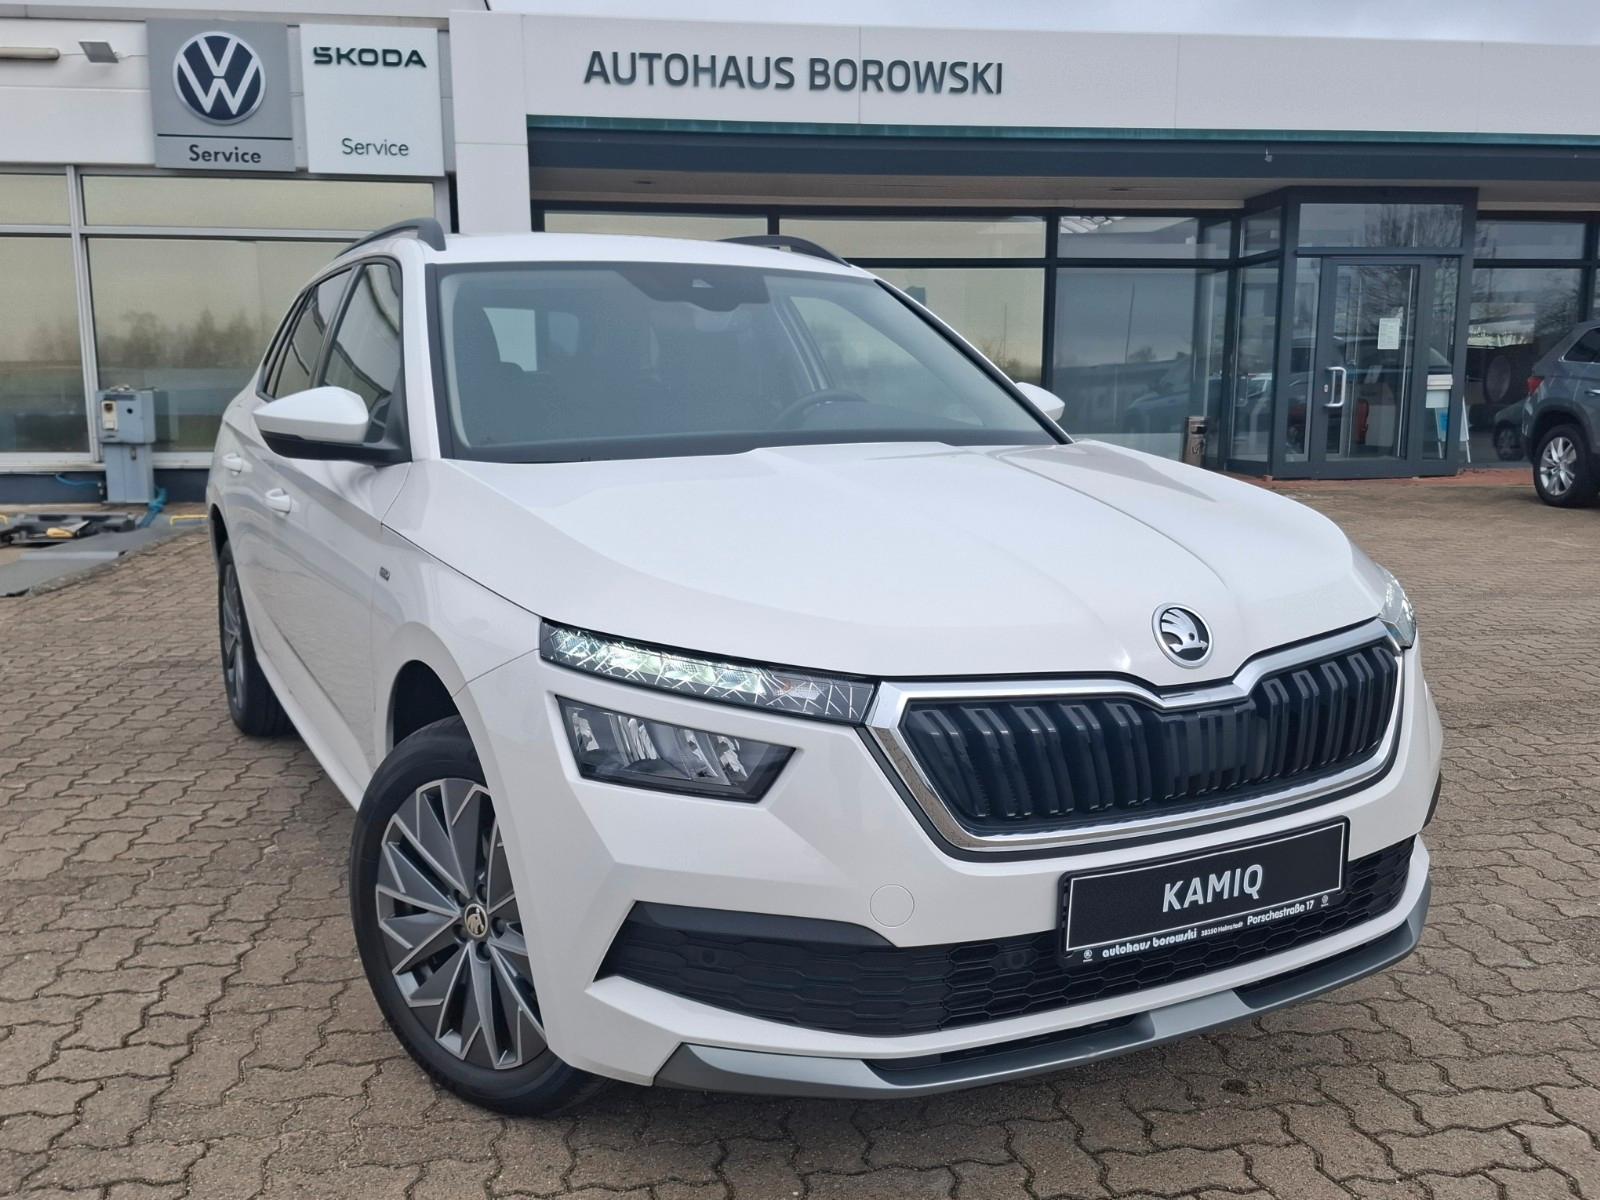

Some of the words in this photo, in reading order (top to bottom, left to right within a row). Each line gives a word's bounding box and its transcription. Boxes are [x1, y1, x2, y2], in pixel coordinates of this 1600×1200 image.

[584, 51, 795, 89] AUTOHAUS
[808, 57, 1004, 95] BOROWSKI
[189, 144, 262, 164] Service
[342, 137, 409, 157] Service
[1162, 864, 1263, 912] KAMIQ
[1102, 940, 1151, 958] autohaus
[1152, 928, 1198, 948] borowski
[1247, 903, 1305, 925] Porschestraße
[1306, 899, 1315, 910] 17
